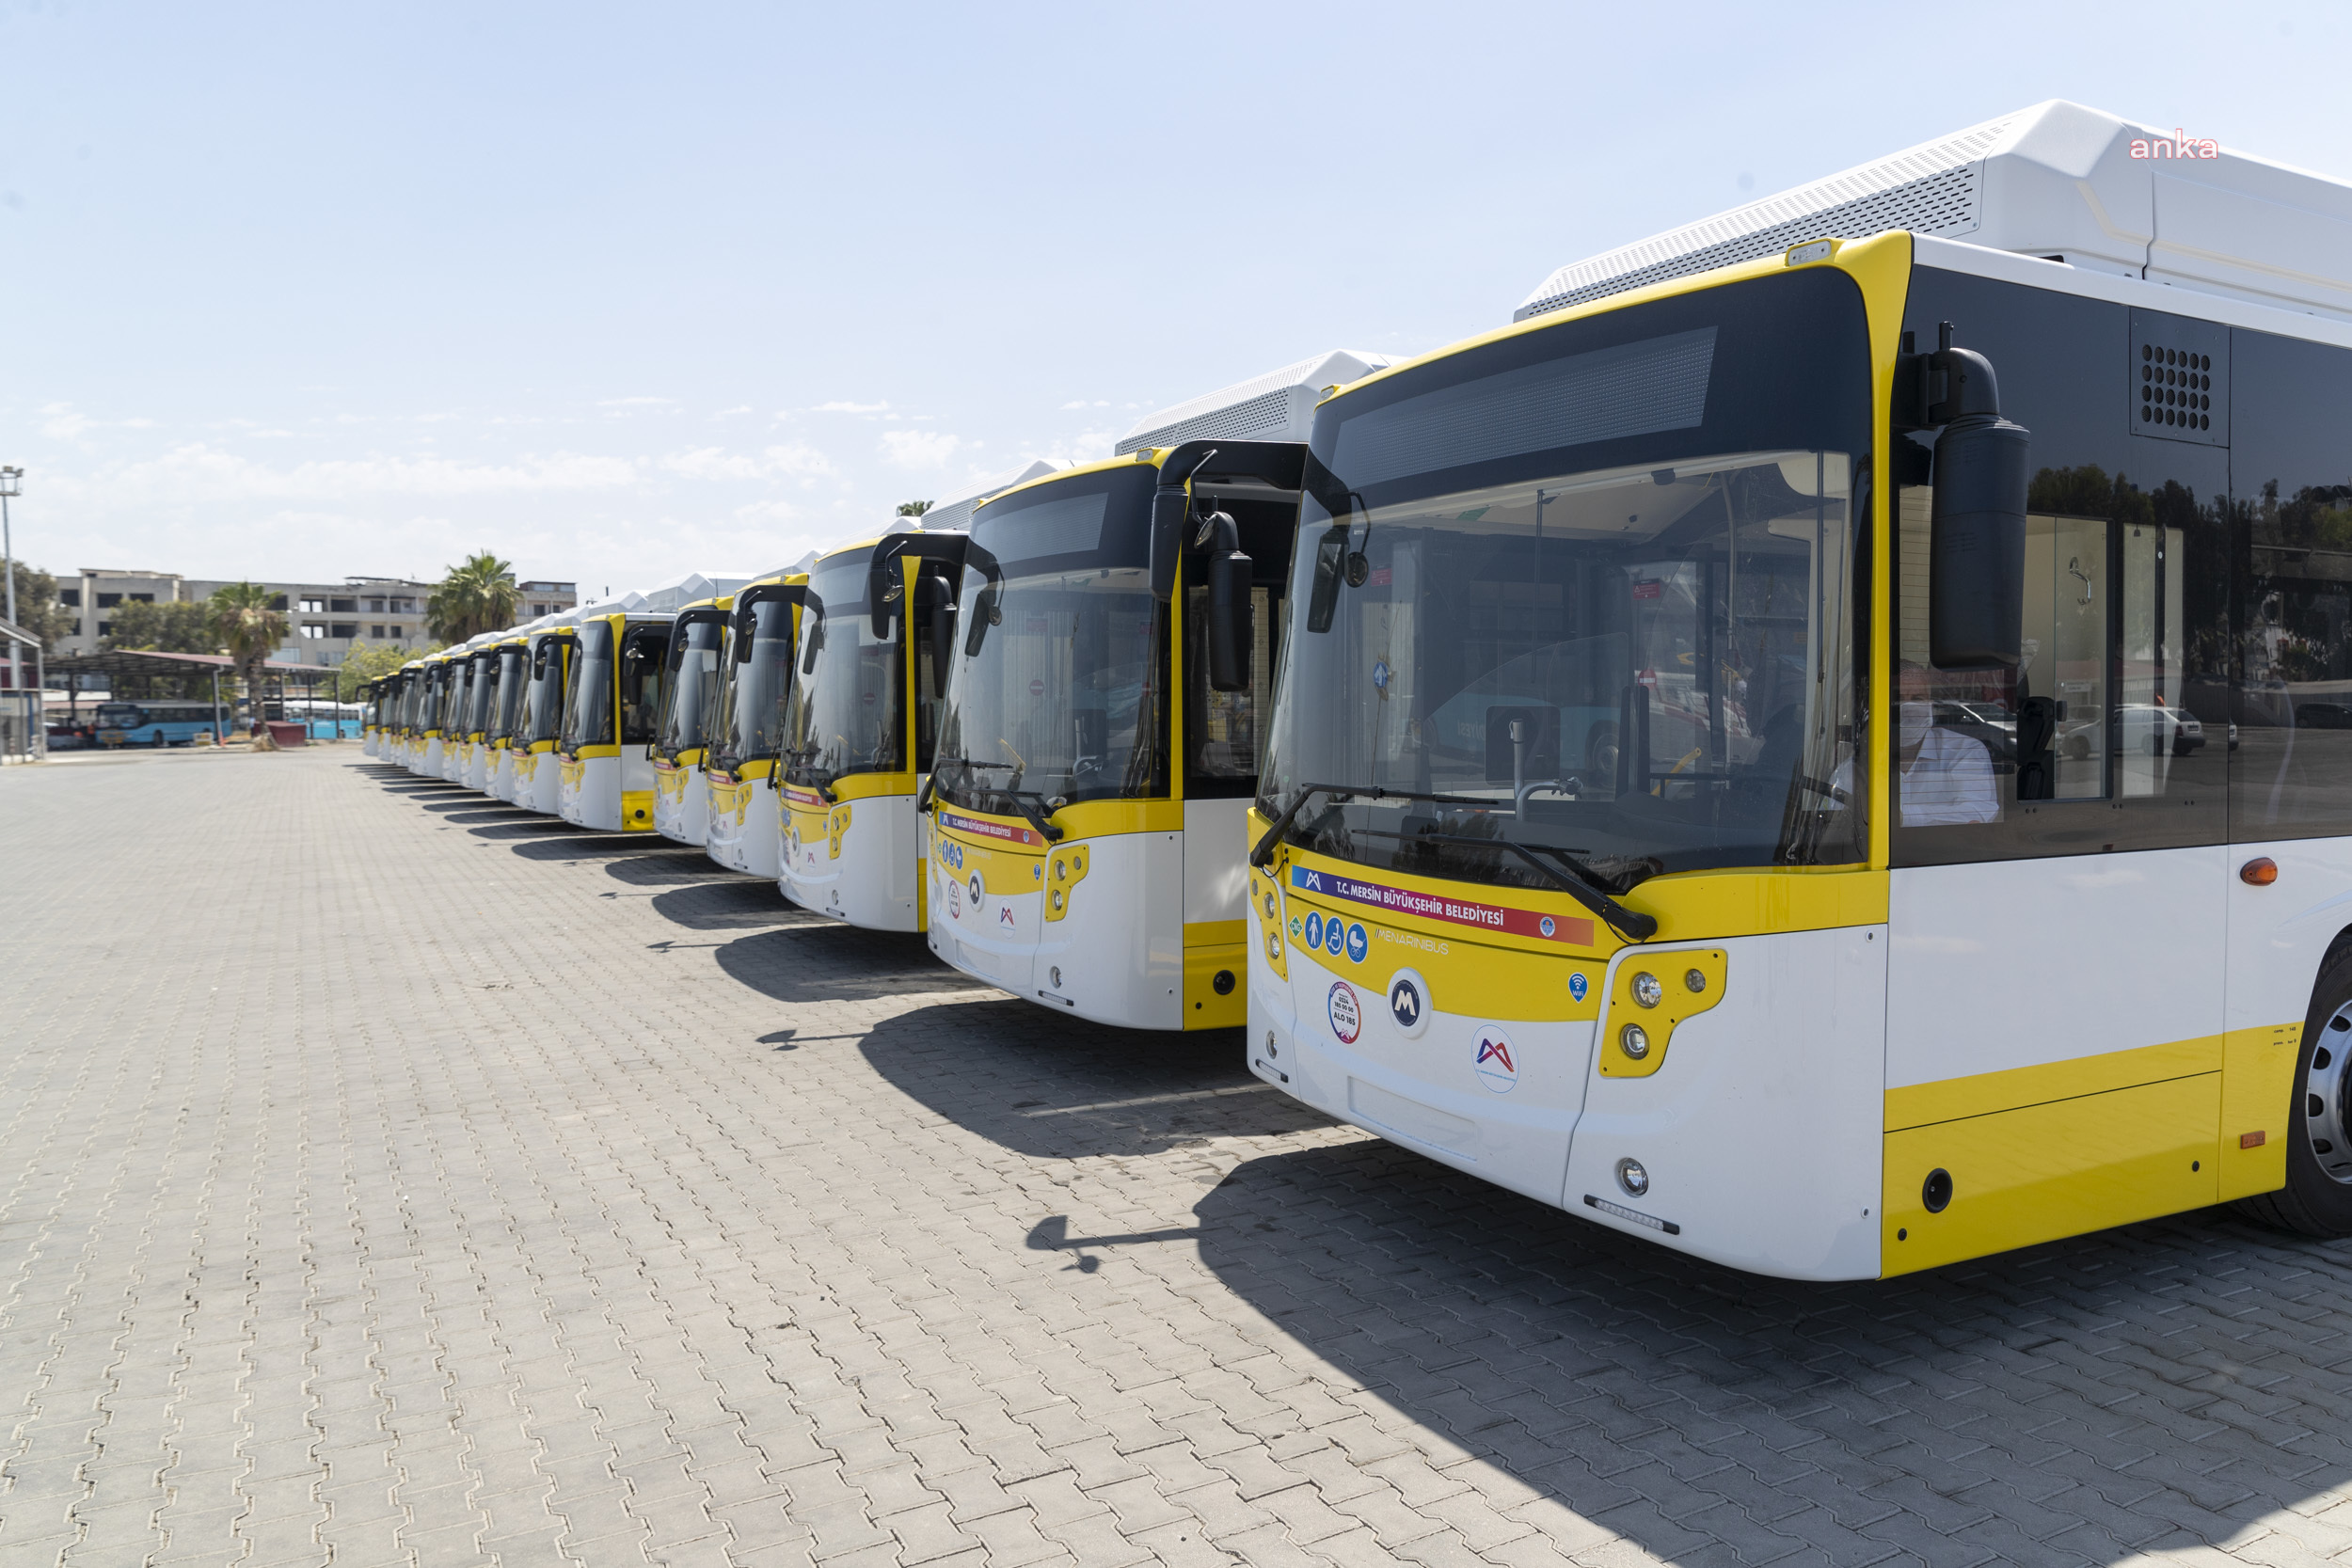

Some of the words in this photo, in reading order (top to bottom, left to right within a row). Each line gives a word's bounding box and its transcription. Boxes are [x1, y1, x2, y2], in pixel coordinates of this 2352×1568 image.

[1336, 880, 1349, 895] T.C.
[1350, 885, 1382, 902] MERSİN
[1383, 889, 1443, 914] BÜYÜKŞEHİR
[1445, 905, 1504, 927] BELEDİYESİ
[1394, 990, 1417, 1017] M
[1333, 1011, 1345, 1022] ALO
[1345, 1016, 1356, 1026] 185
